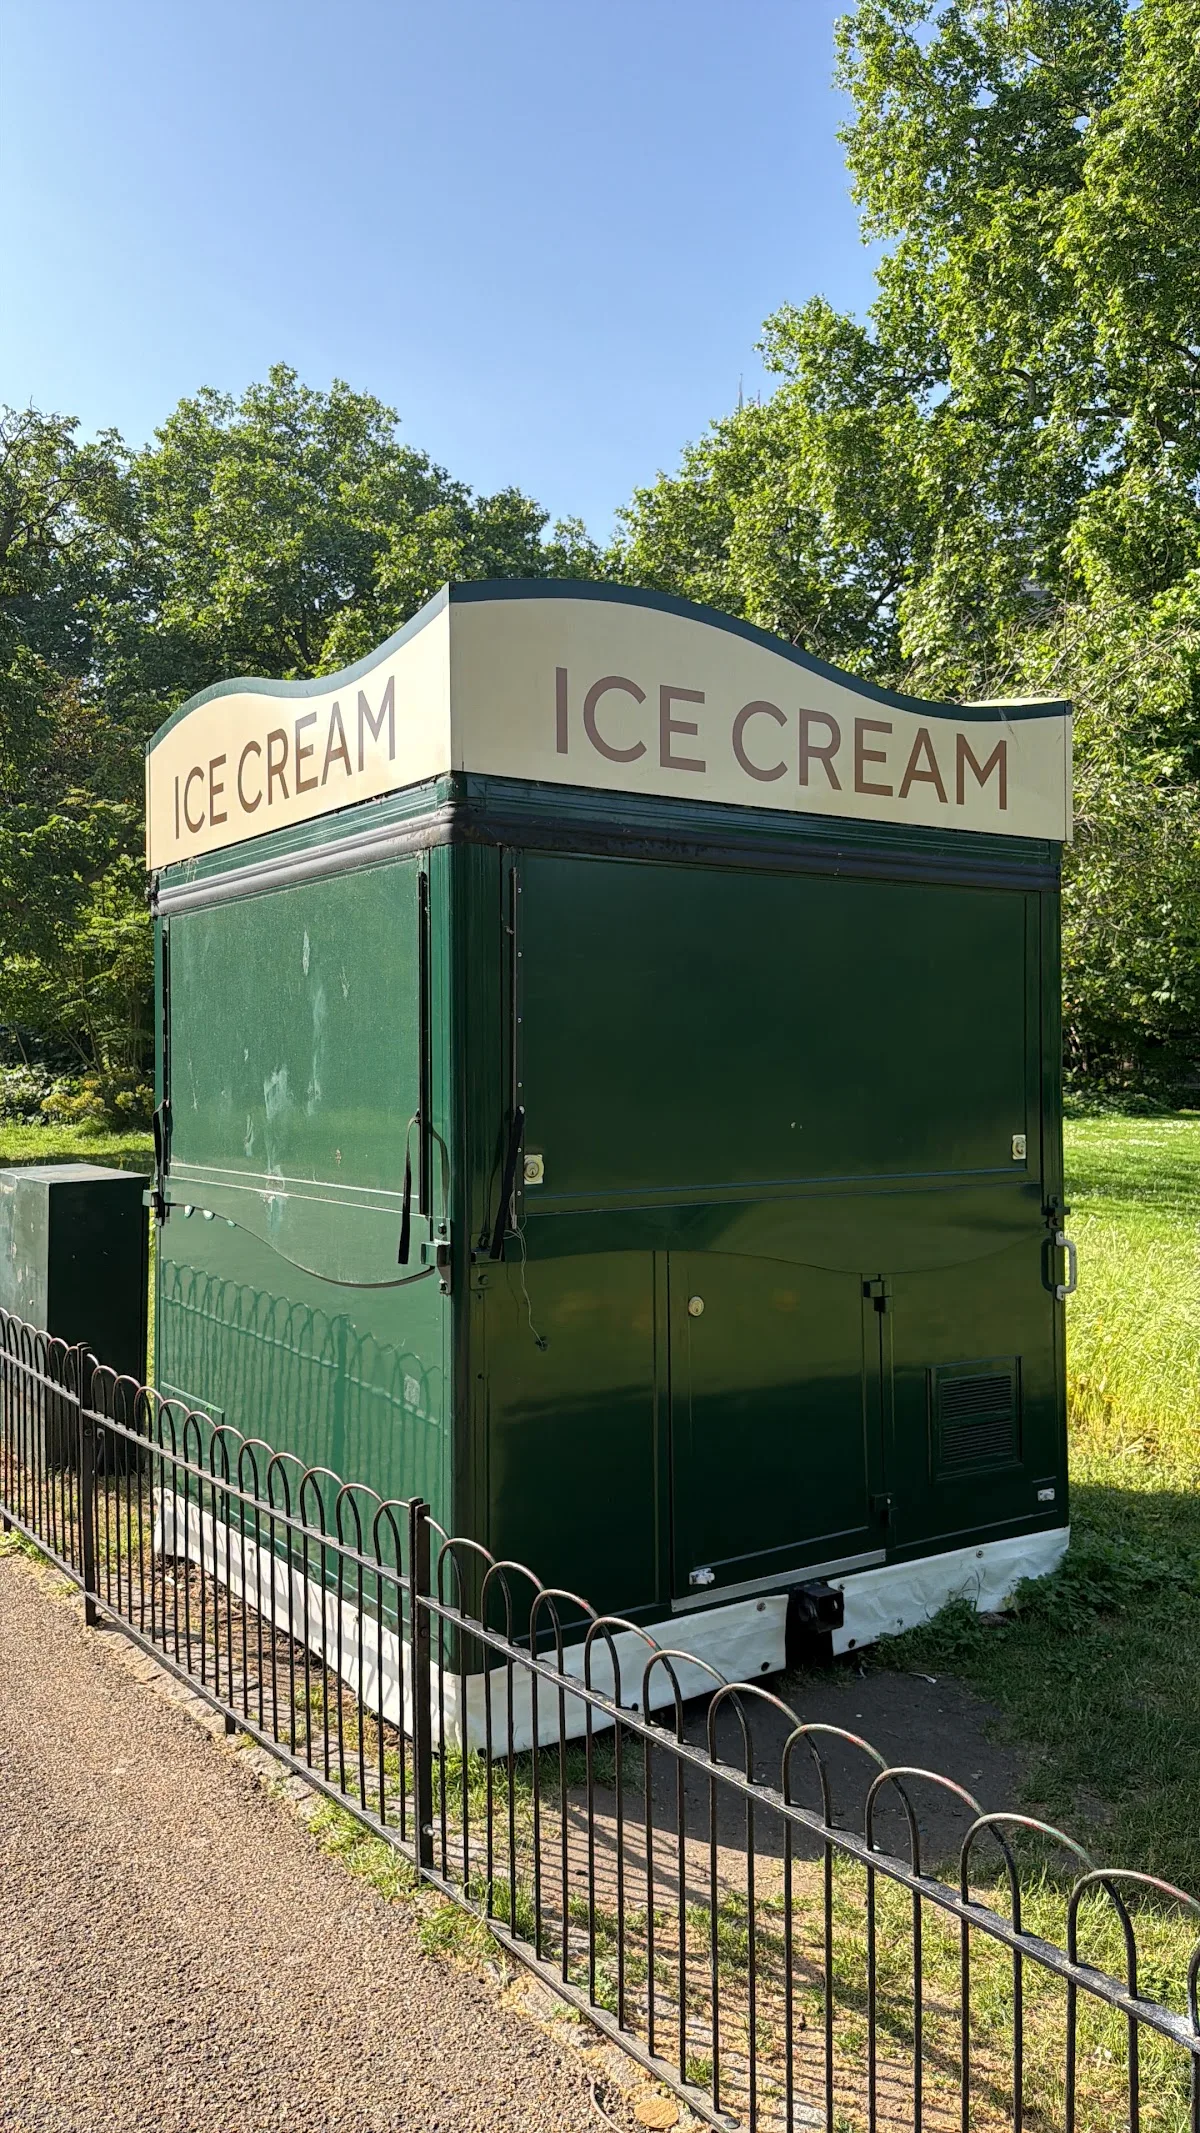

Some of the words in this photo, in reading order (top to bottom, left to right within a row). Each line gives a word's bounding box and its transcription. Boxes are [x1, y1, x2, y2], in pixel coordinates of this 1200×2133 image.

[174, 753, 228, 840] ICE
[237, 675, 395, 814] CREAM
[555, 667, 706, 773] ICE
[732, 700, 1008, 811] CREAM
